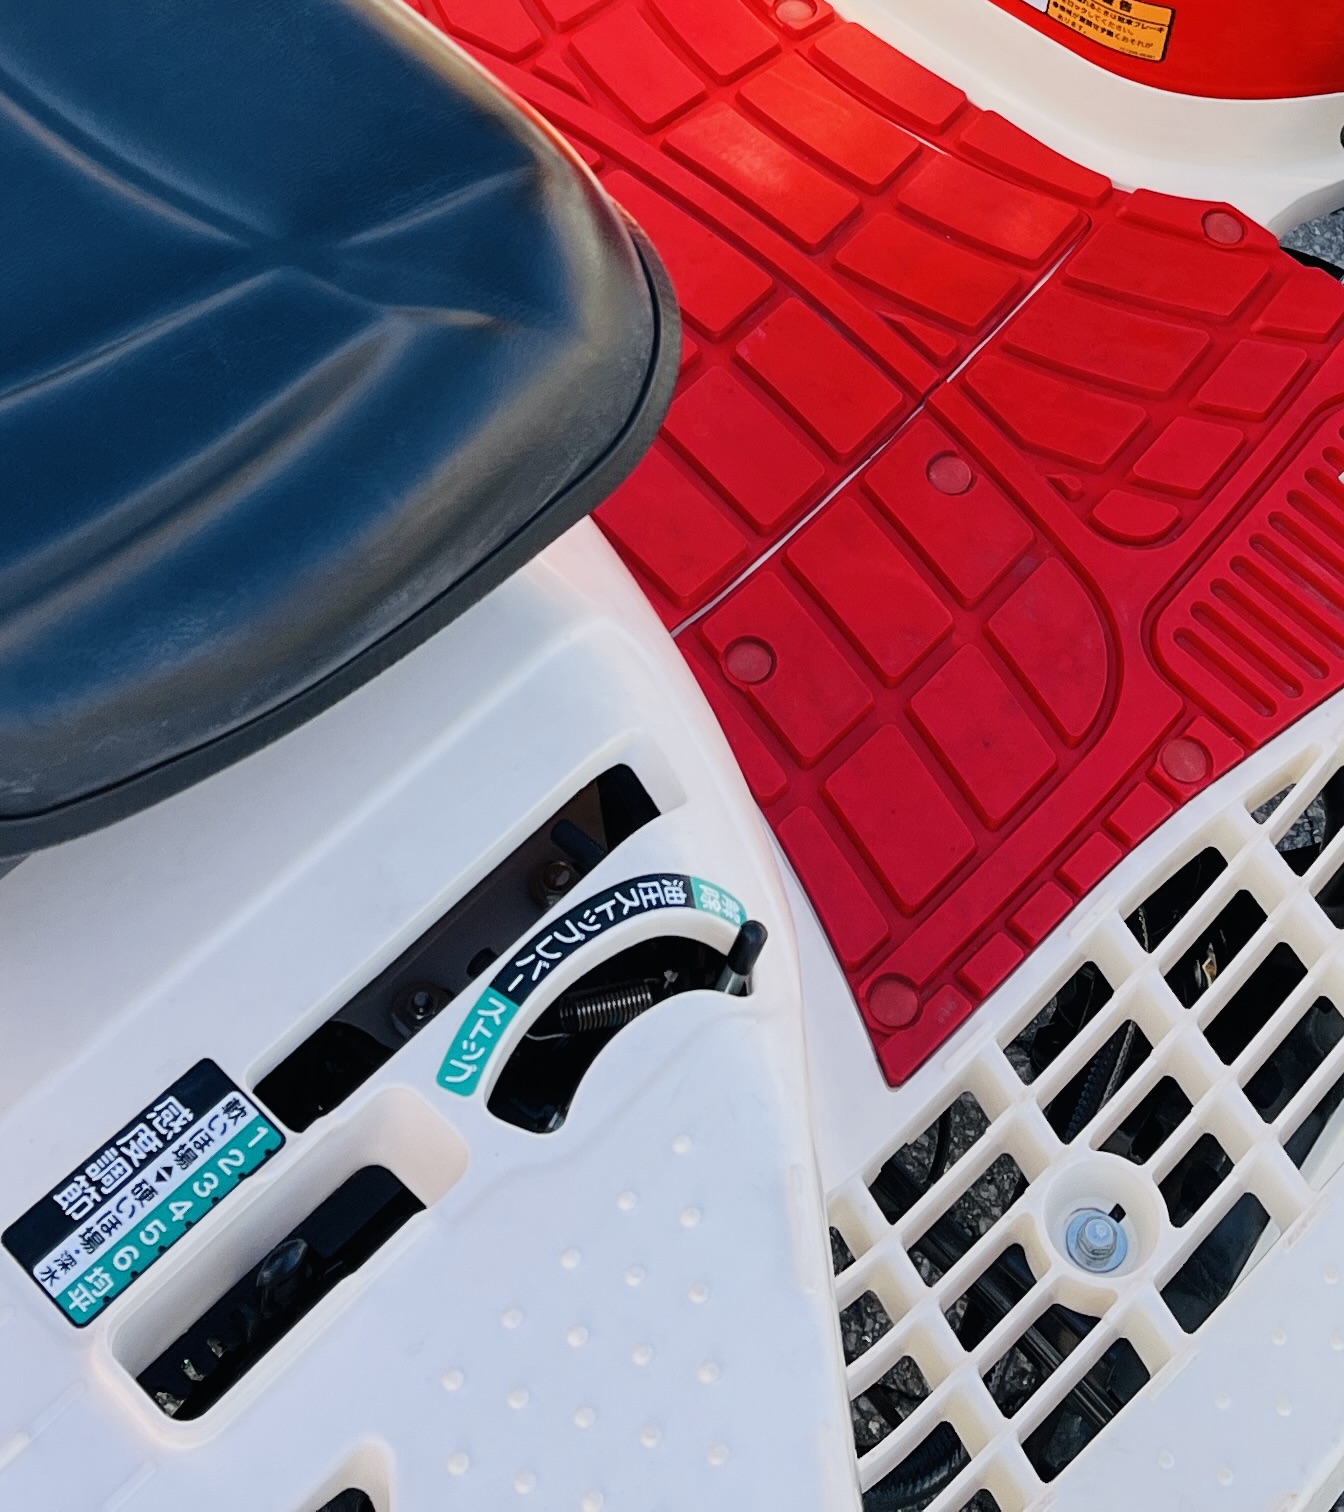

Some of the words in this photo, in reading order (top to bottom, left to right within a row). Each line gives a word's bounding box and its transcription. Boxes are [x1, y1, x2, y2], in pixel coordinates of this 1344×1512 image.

[506, 878, 688, 993] 油圧ストップレバー
[444, 996, 505, 1083] ストップ
[246, 1125, 269, 1149] 1
[52, 1095, 194, 1220] 感度調節
[217, 1148, 245, 1176] 2
[192, 1171, 219, 1199] 3
[168, 1199, 194, 1222] 4
[139, 1218, 167, 1246] 5
[112, 1245, 140, 1272] 6
[67, 1265, 115, 1313] 均平
